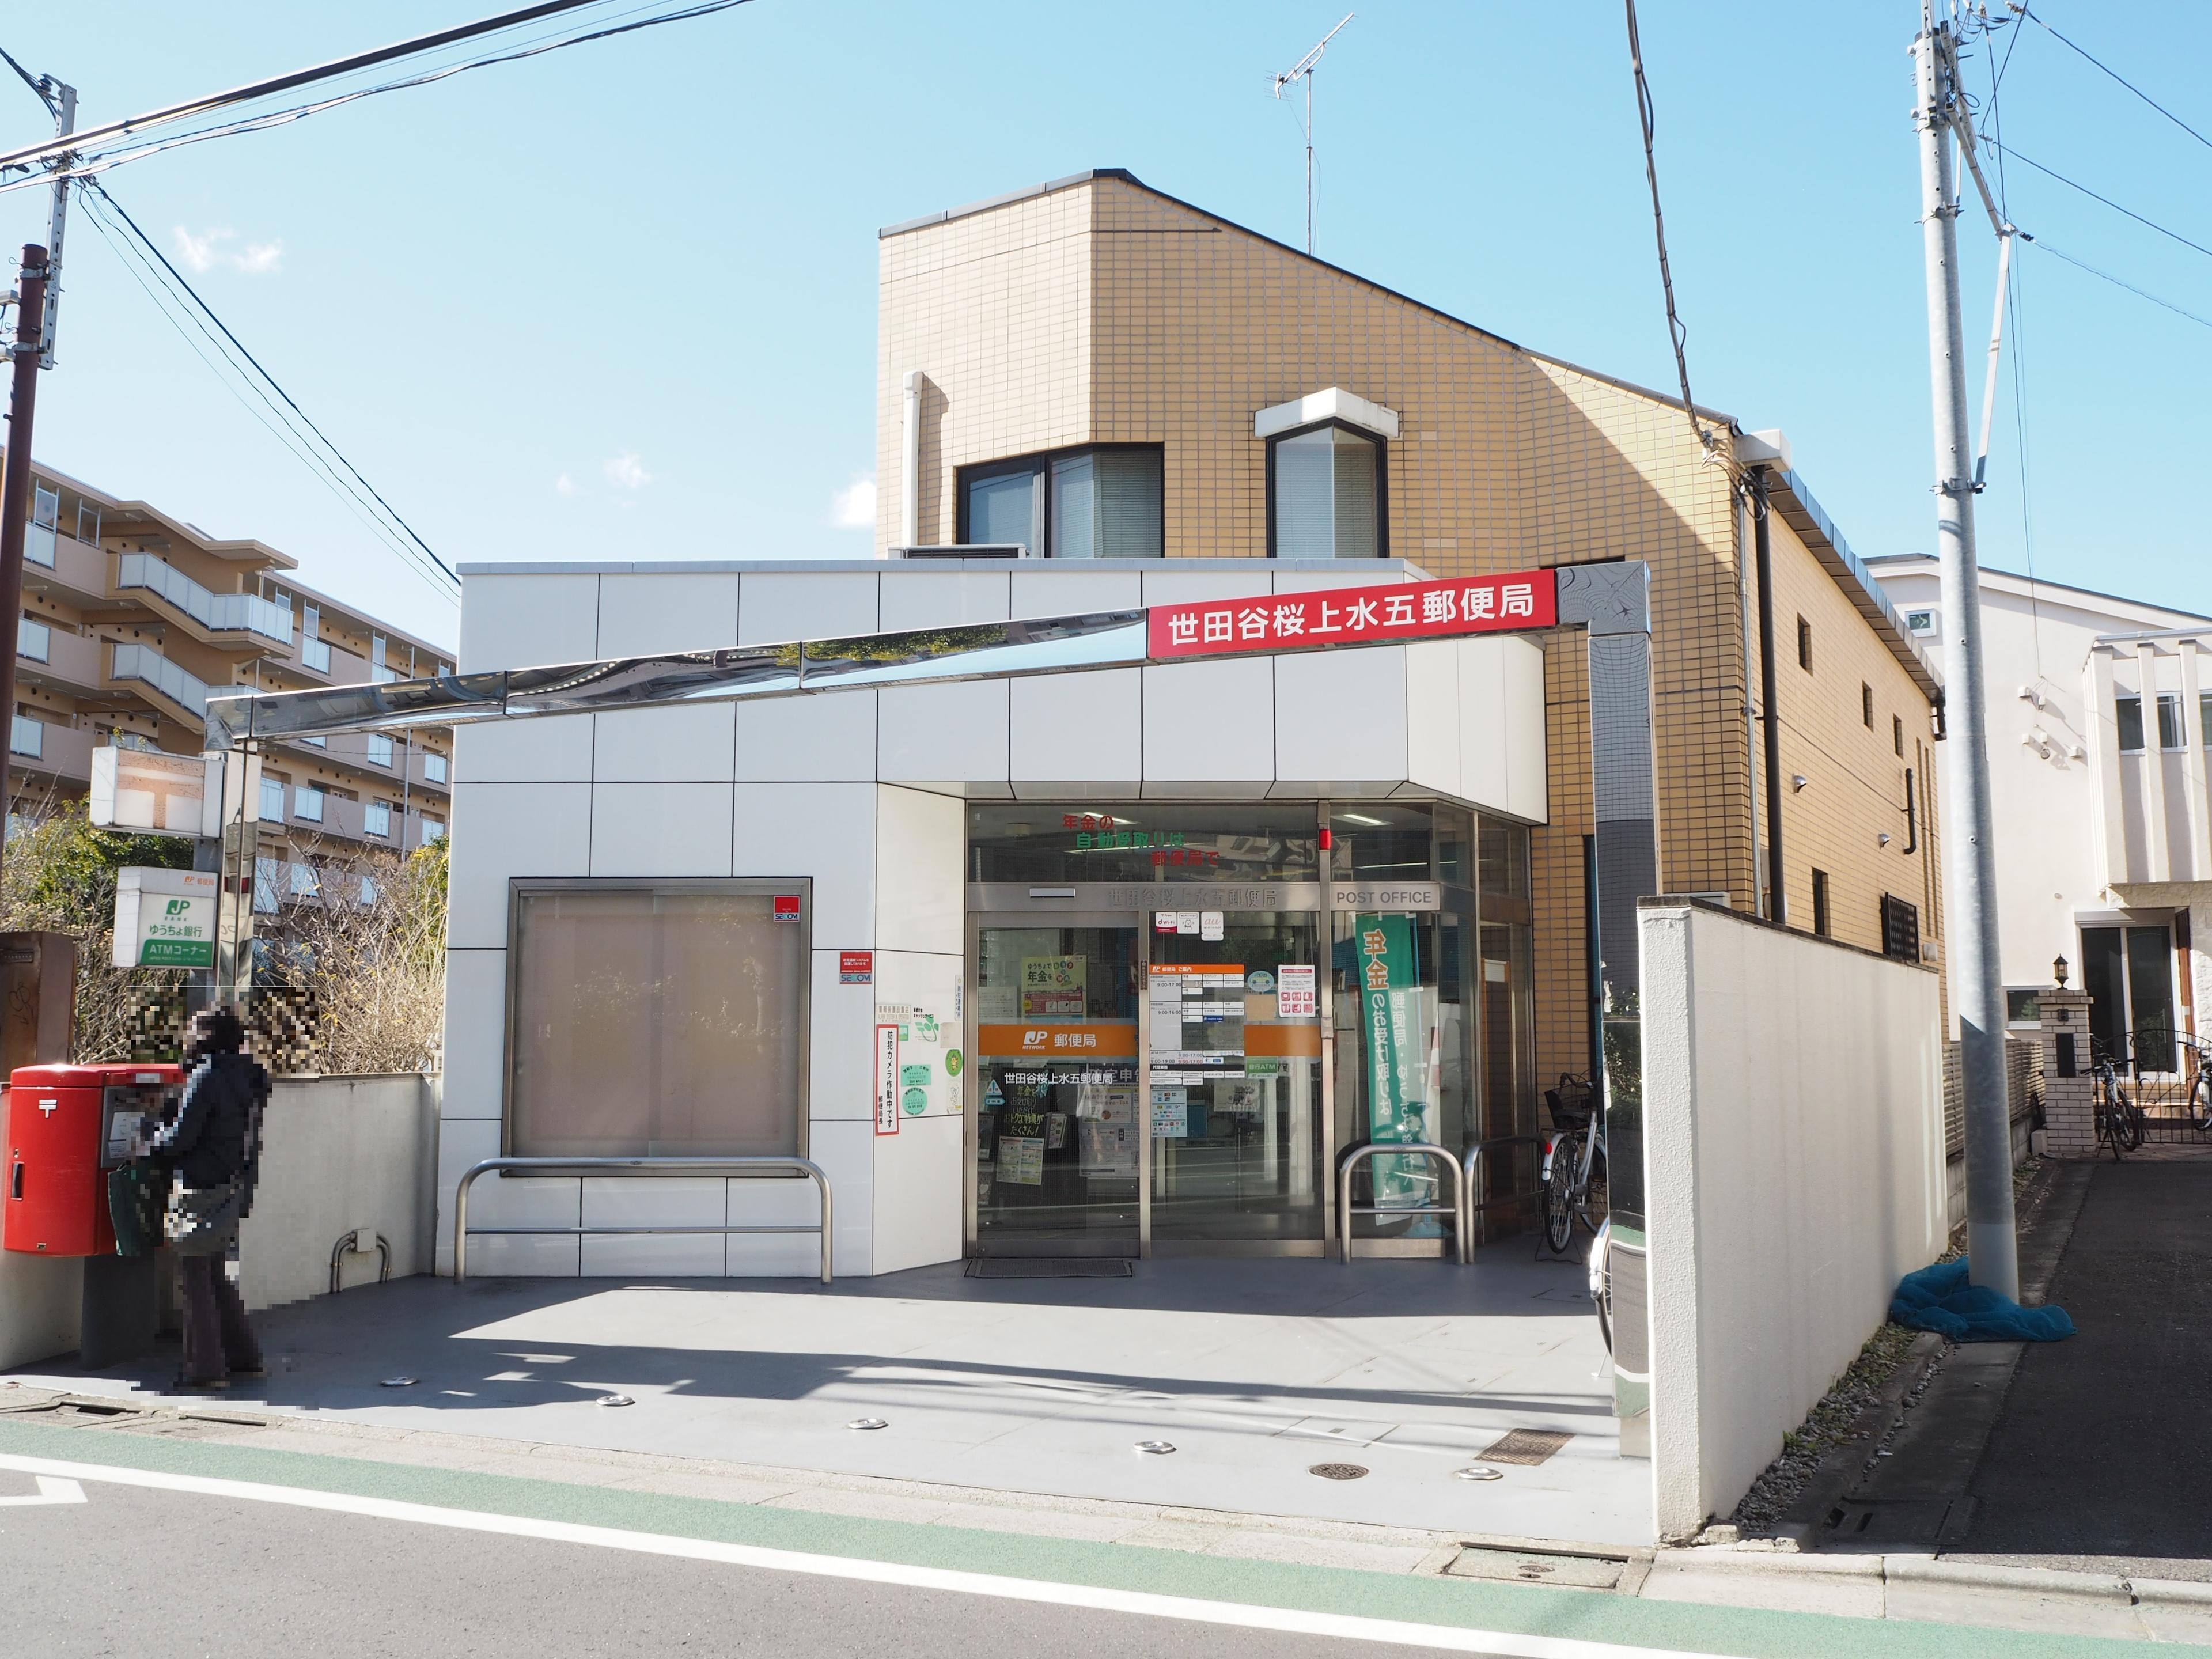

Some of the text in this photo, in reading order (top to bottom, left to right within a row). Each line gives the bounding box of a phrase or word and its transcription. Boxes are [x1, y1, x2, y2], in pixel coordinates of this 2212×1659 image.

[1168, 582, 1534, 646] 世田谷桜上水五郵便局
[1062, 814, 1115, 830] 年金の
[1077, 832, 1185, 849] 自動受取りは
[1151, 850, 1221, 867] 郵便局で
[1108, 888, 1278, 908] 世田谷桜上水五郵便局
[1336, 891, 1433, 904] POST OFFICE
[149, 924, 203, 938] ゆうちょ銀行
[149, 944, 207, 955] ATMコーナー
[1027, 970, 1052, 983] 年金を
[1054, 1033, 1097, 1048] 郵便局
[1005, 1072, 1113, 1085] 世田谷桜上水五郵便局
